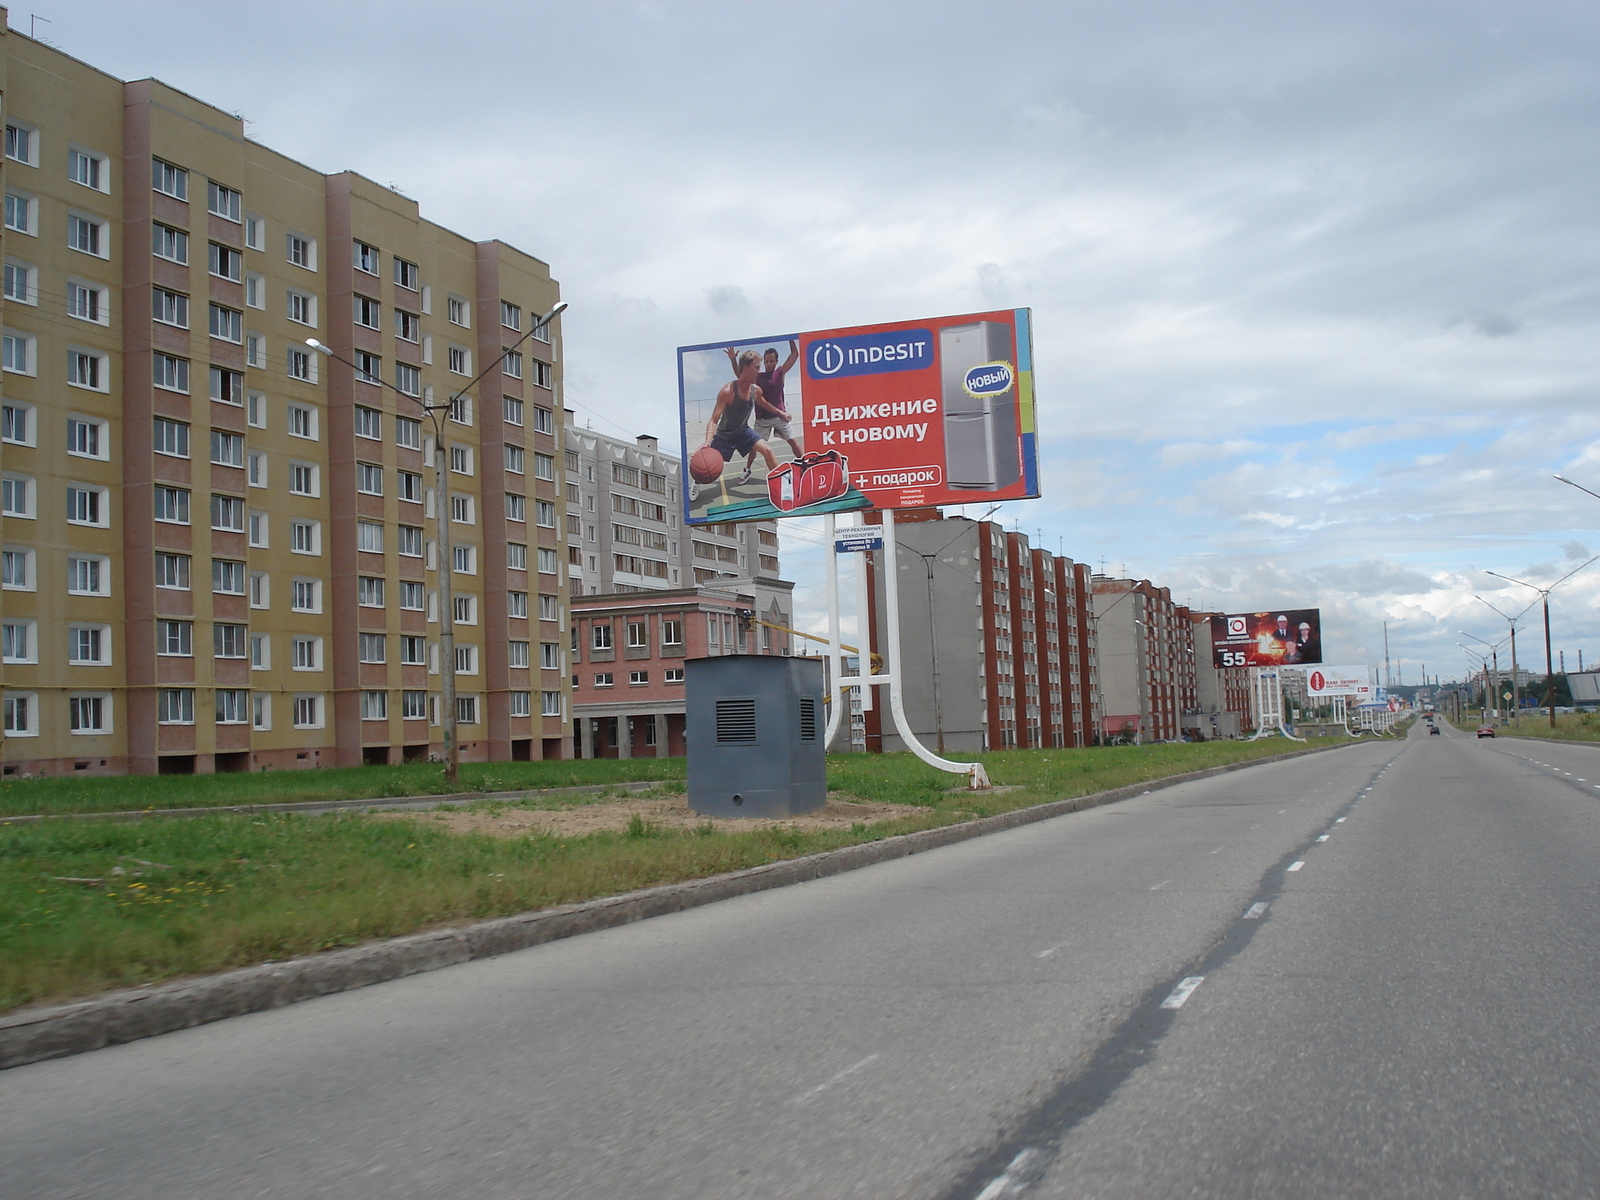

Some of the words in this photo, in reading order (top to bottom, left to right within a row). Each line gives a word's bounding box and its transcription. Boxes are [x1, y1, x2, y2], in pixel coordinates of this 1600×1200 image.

[968, 367, 1009, 390] НОВЫЙ
[811, 398, 938, 428] Движение
[822, 430, 836, 445] к
[840, 422, 929, 444] новому
[872, 470, 934, 485] подарок
[1222, 651, 1247, 667] 55
